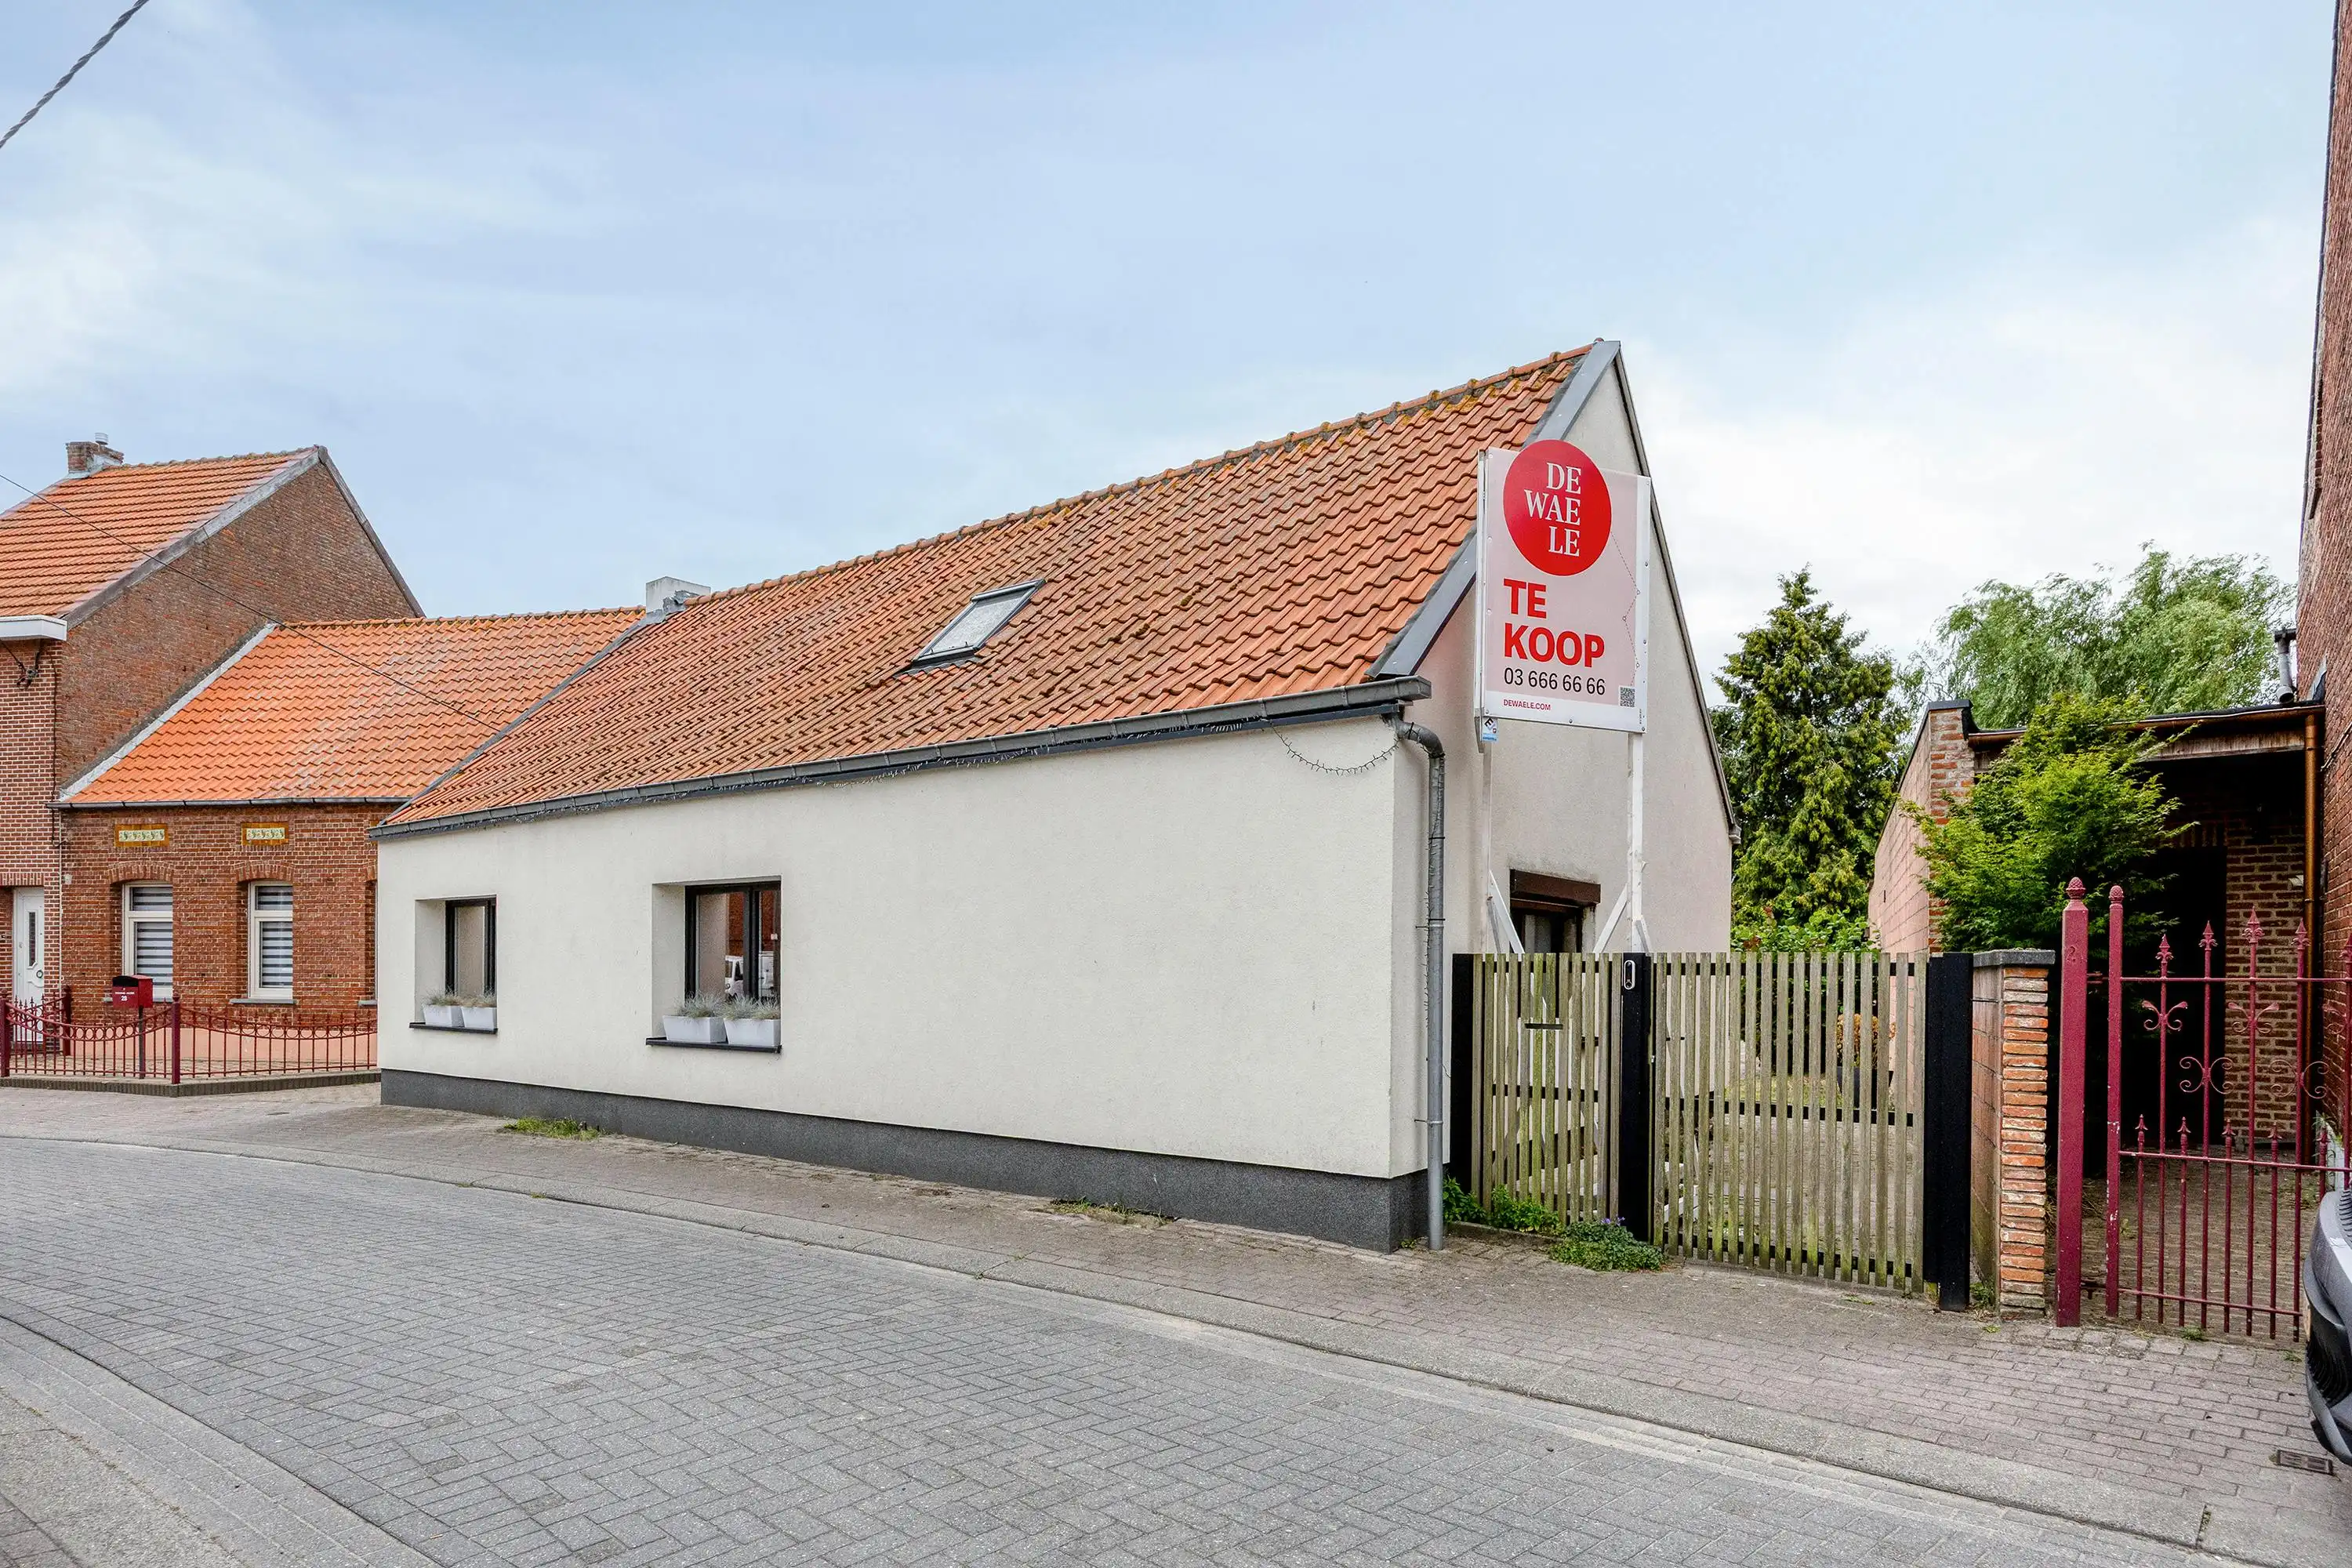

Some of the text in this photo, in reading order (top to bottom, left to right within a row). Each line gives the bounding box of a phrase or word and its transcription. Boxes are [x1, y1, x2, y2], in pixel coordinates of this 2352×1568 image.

[1546, 463, 1581, 495] DE
[1524, 490, 1581, 526] WAE
[1548, 525, 1580, 557] LE
[1504, 579, 1547, 619] TE
[1504, 622, 1605, 668] KOOP
[1504, 668, 1606, 695] 03 666 66 66
[1503, 699, 1551, 710] DEWAELE.COM
